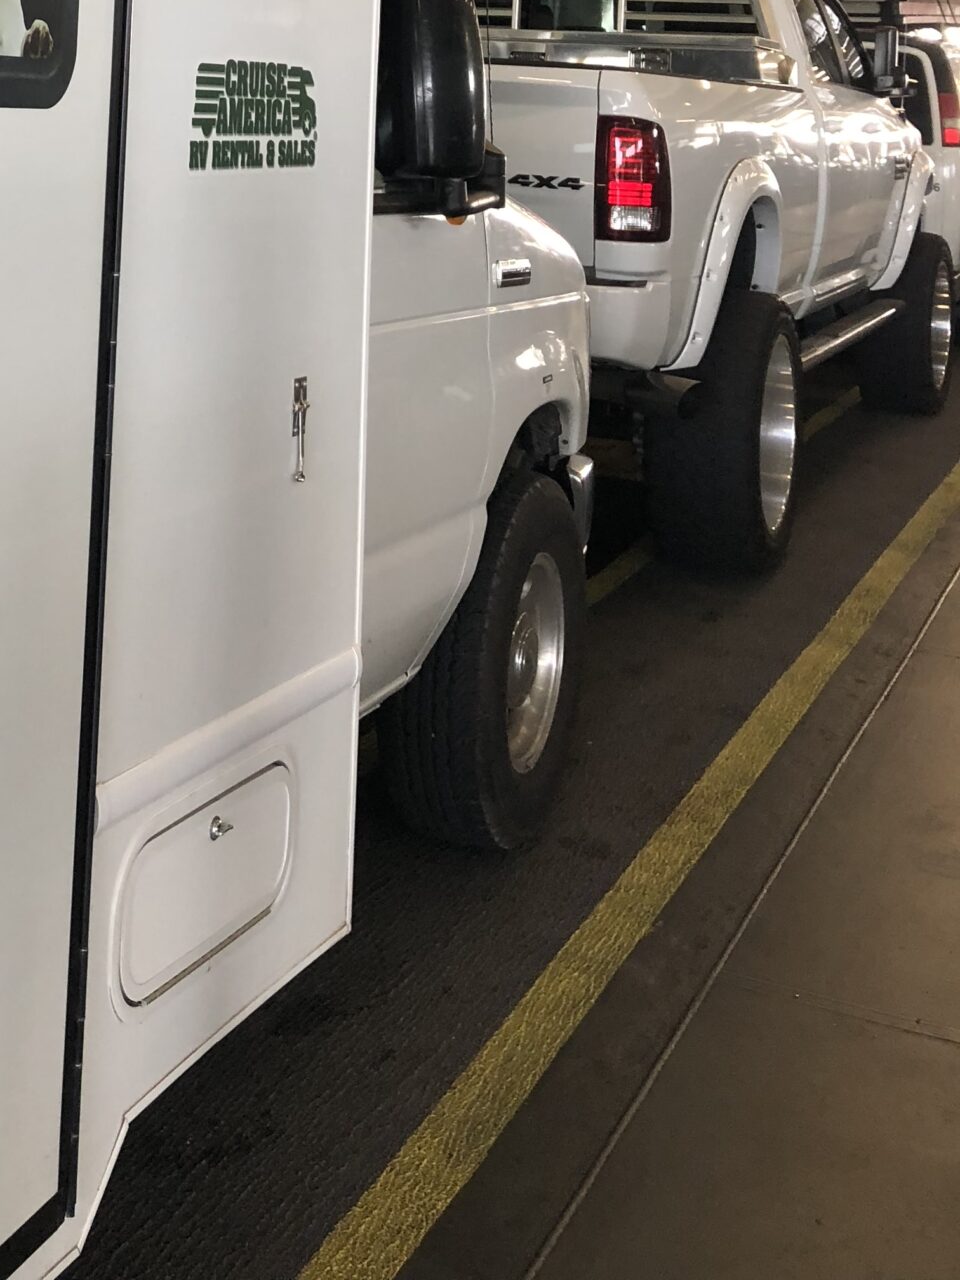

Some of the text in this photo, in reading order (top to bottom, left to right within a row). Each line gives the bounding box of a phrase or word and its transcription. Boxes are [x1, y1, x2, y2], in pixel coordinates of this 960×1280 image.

[225, 59, 288, 98] CRUISE
[216, 97, 292, 135] AMERICA
[189, 139, 316, 170] RV RENTAL & SALES
